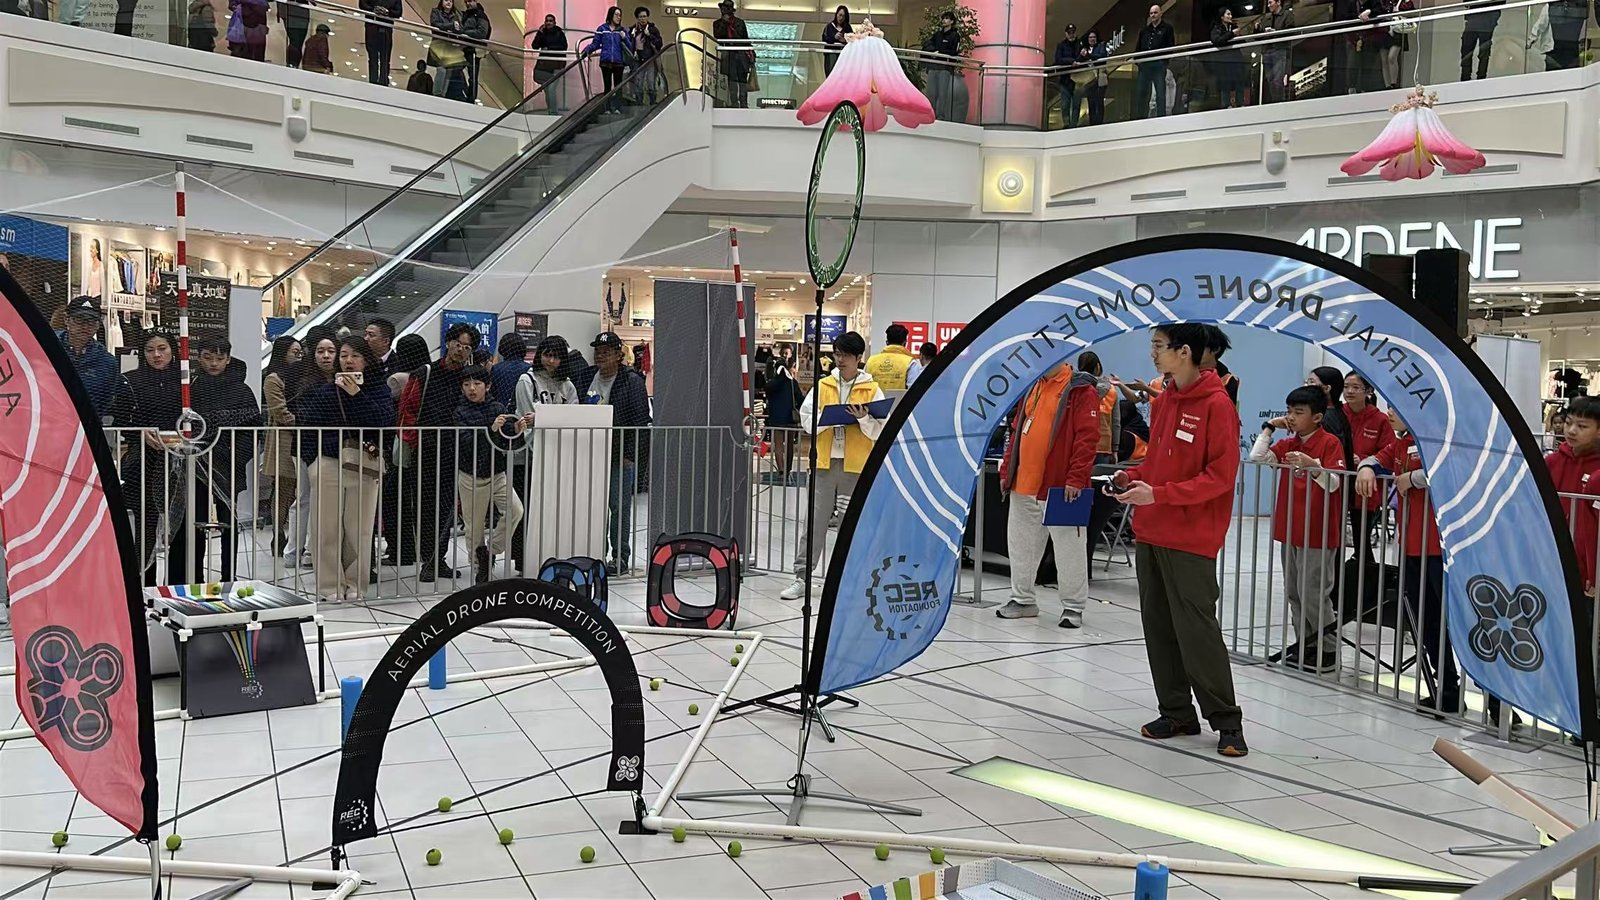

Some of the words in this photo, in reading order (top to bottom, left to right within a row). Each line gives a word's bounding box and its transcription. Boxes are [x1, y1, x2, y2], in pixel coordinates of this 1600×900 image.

[164, 280, 228, 300] 天真如堂
[940, 327, 961, 341] UN
[387, 623, 444, 682] AERIAL
[446, 591, 509, 627] DRONE
[514, 590, 617, 655] COMPETITION
[340, 807, 361, 821] REC
